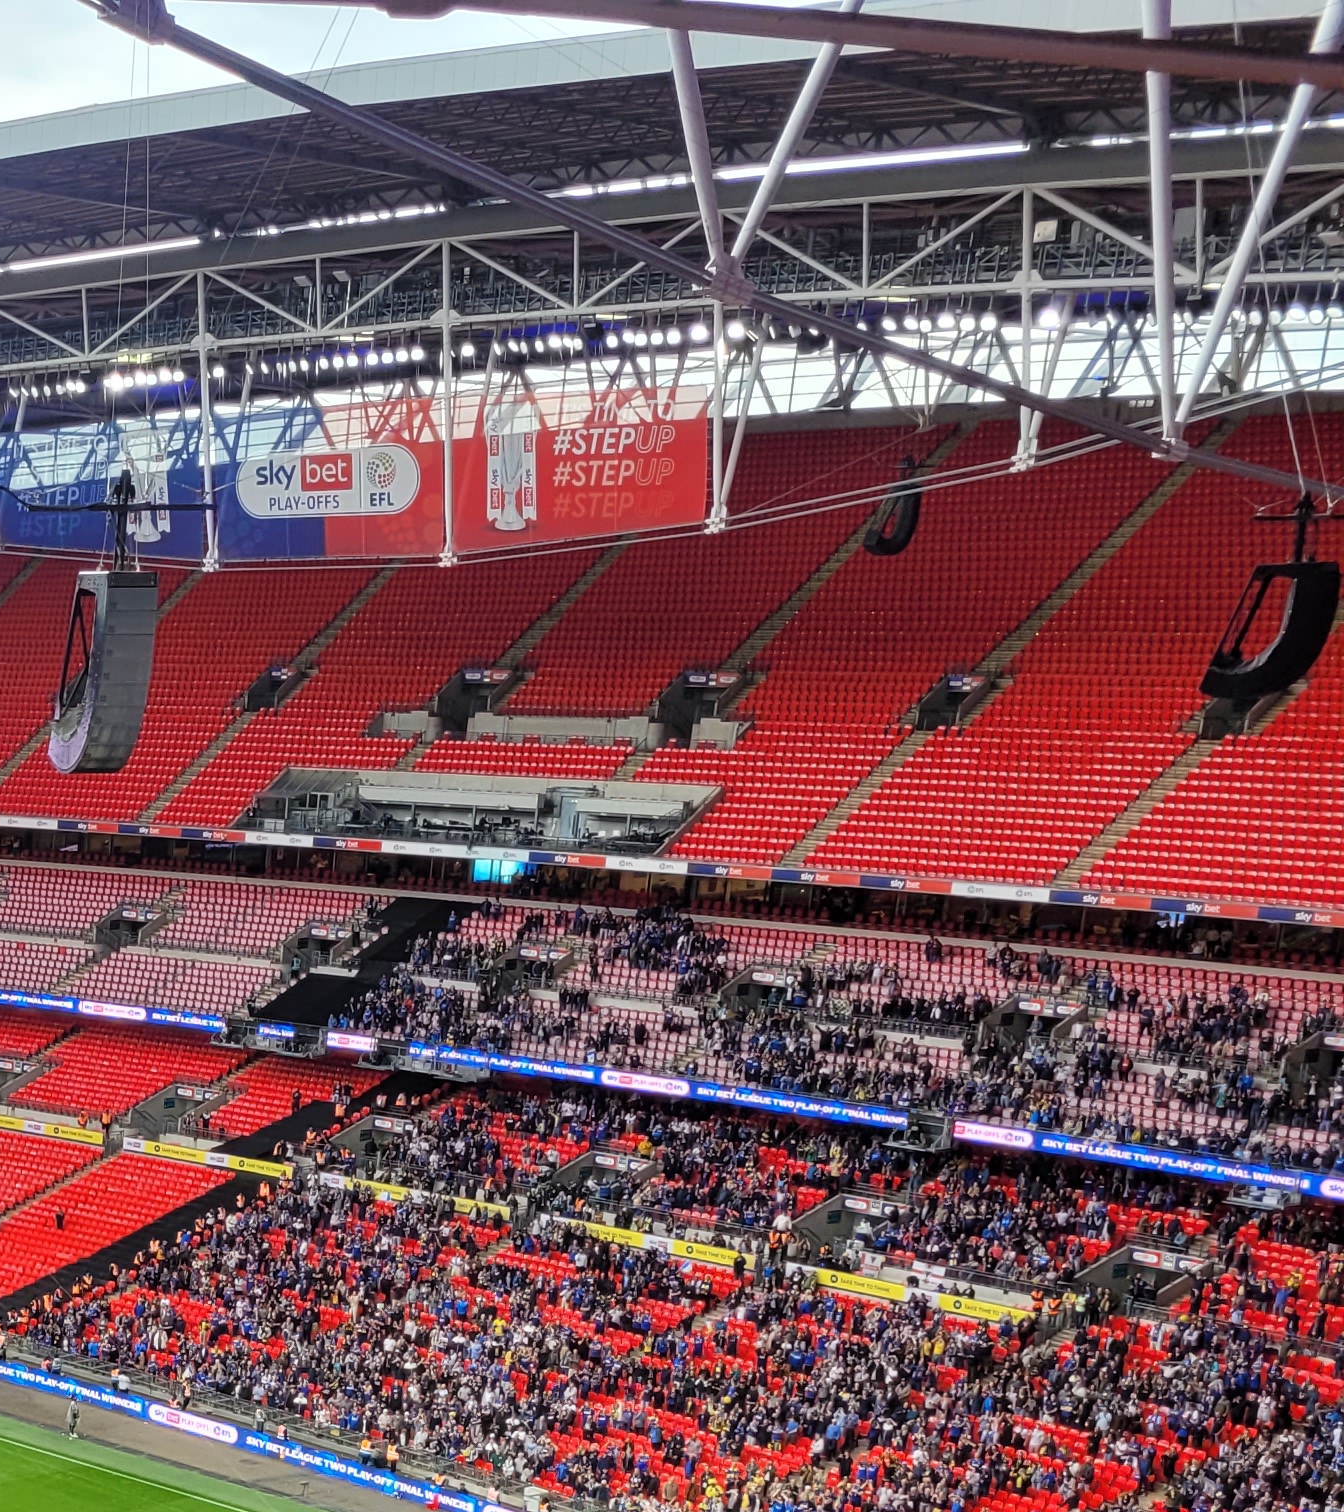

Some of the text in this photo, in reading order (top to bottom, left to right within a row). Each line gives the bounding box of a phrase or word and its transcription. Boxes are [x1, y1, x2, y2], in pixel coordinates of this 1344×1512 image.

[553, 425, 676, 456] #STEPUP
[256, 458, 348, 491] sky bet
[553, 458, 675, 487] #STEPUP
[269, 494, 340, 511] PLAY-OFFS
[370, 492, 394, 507] EFL
[554, 855, 580, 864] sky bet
[715, 866, 742, 876] sky bet
[801, 872, 829, 882] sky bet
[890, 879, 920, 889] sky bet
[1083, 894, 1115, 905] sky bet
[1186, 902, 1220, 913] sky bet
[1295, 911, 1331, 923] sky bet
[698, 1087, 714, 1097] SKY
[716, 1089, 734, 1099] BET
[736, 1091, 772, 1105] LEAGUE
[773, 1097, 794, 1108] TWO
[796, 1099, 842, 1114] PLAY-OFF
[843, 1108, 871, 1120] FINAL
[1042, 1139, 1064, 1150] SKY
[1065, 1142, 1088, 1153] BET
[1089, 1145, 1133, 1161] LEAGUE
[1134, 1153, 1159, 1165] TWO
[1160, 1157, 1217, 1175] PLAY-OFF
[1217, 1166, 1252, 1179] FINAL
[15, 1367, 35, 1382] TWO
[36, 1371, 75, 1391] PLAY-OFF
[76, 1384, 100, 1399] FINAL
[102, 1392, 142, 1411] WINNERS
[246, 1436, 266, 1448] SKY
[267, 1442, 285, 1454] BET
[286, 1447, 322, 1466] LEAGUE
[323, 1456, 346, 1473] TWO
[347, 1467, 393, 1487] PLAY-OFF
[394, 1480, 423, 1498] FINAL
